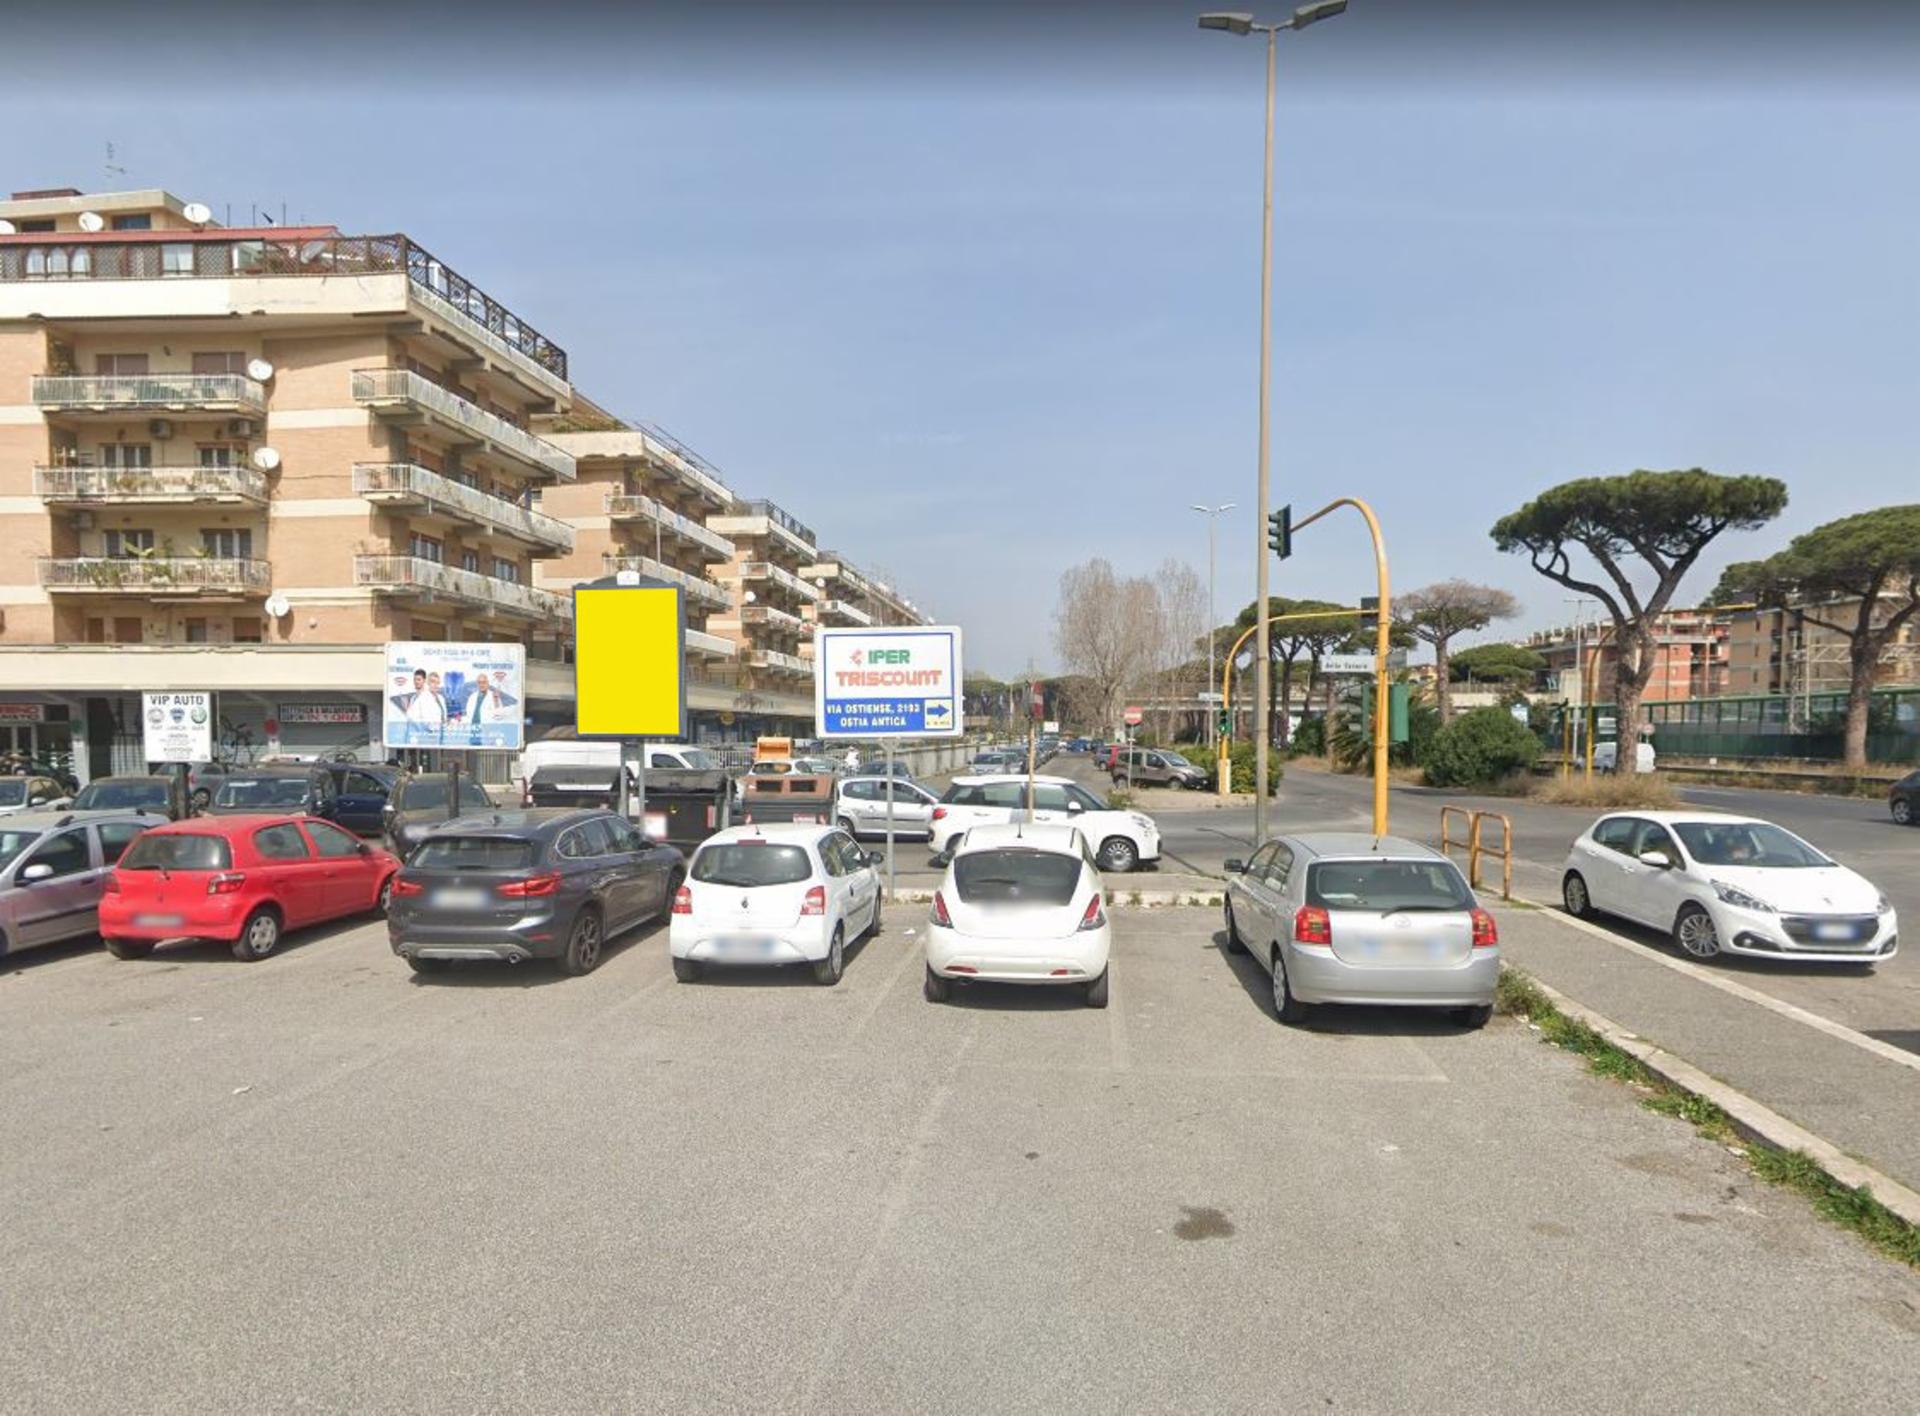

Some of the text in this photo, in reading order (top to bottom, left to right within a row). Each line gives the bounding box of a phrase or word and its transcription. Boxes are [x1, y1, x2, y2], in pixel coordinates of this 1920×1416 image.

[868, 649, 911, 664] IPER
[835, 669, 942, 687] TRISCOUNT
[150, 695, 205, 706] VIP AUTO
[826, 704, 842, 714] VIA
[840, 716, 907, 727] OSTIA ANTICA
